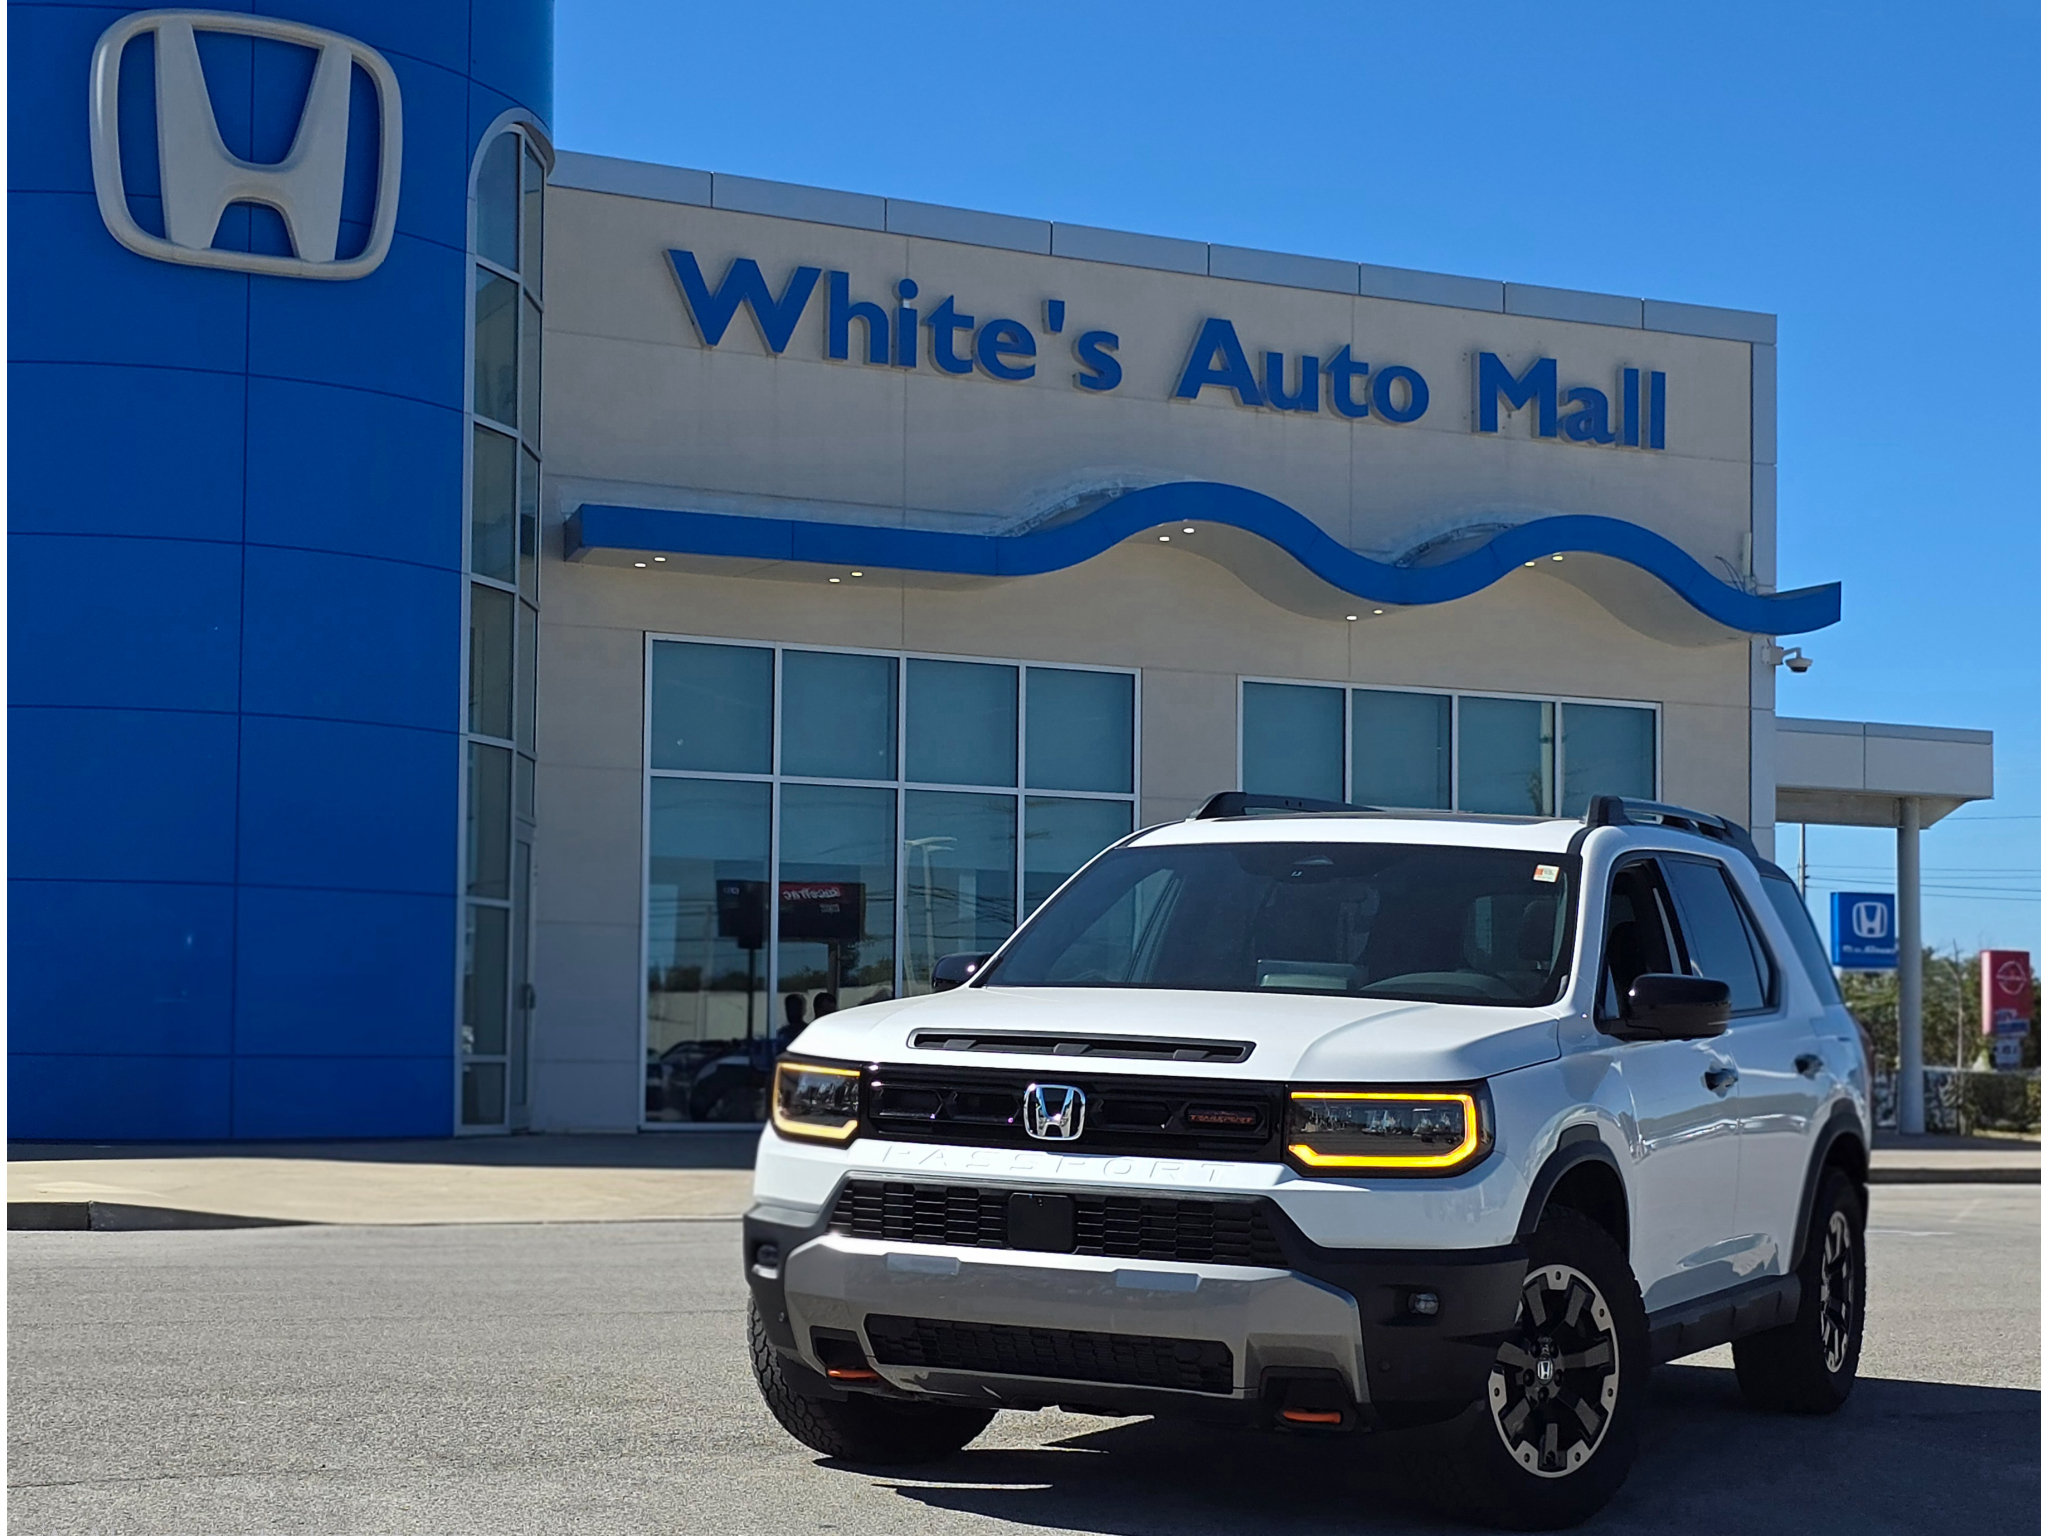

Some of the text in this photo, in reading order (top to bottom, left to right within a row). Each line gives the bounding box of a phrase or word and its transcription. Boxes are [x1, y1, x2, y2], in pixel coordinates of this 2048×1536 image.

[665, 249, 1666, 450] White's Auto Mall
[882, 1145, 1235, 1183] PASSPORT
